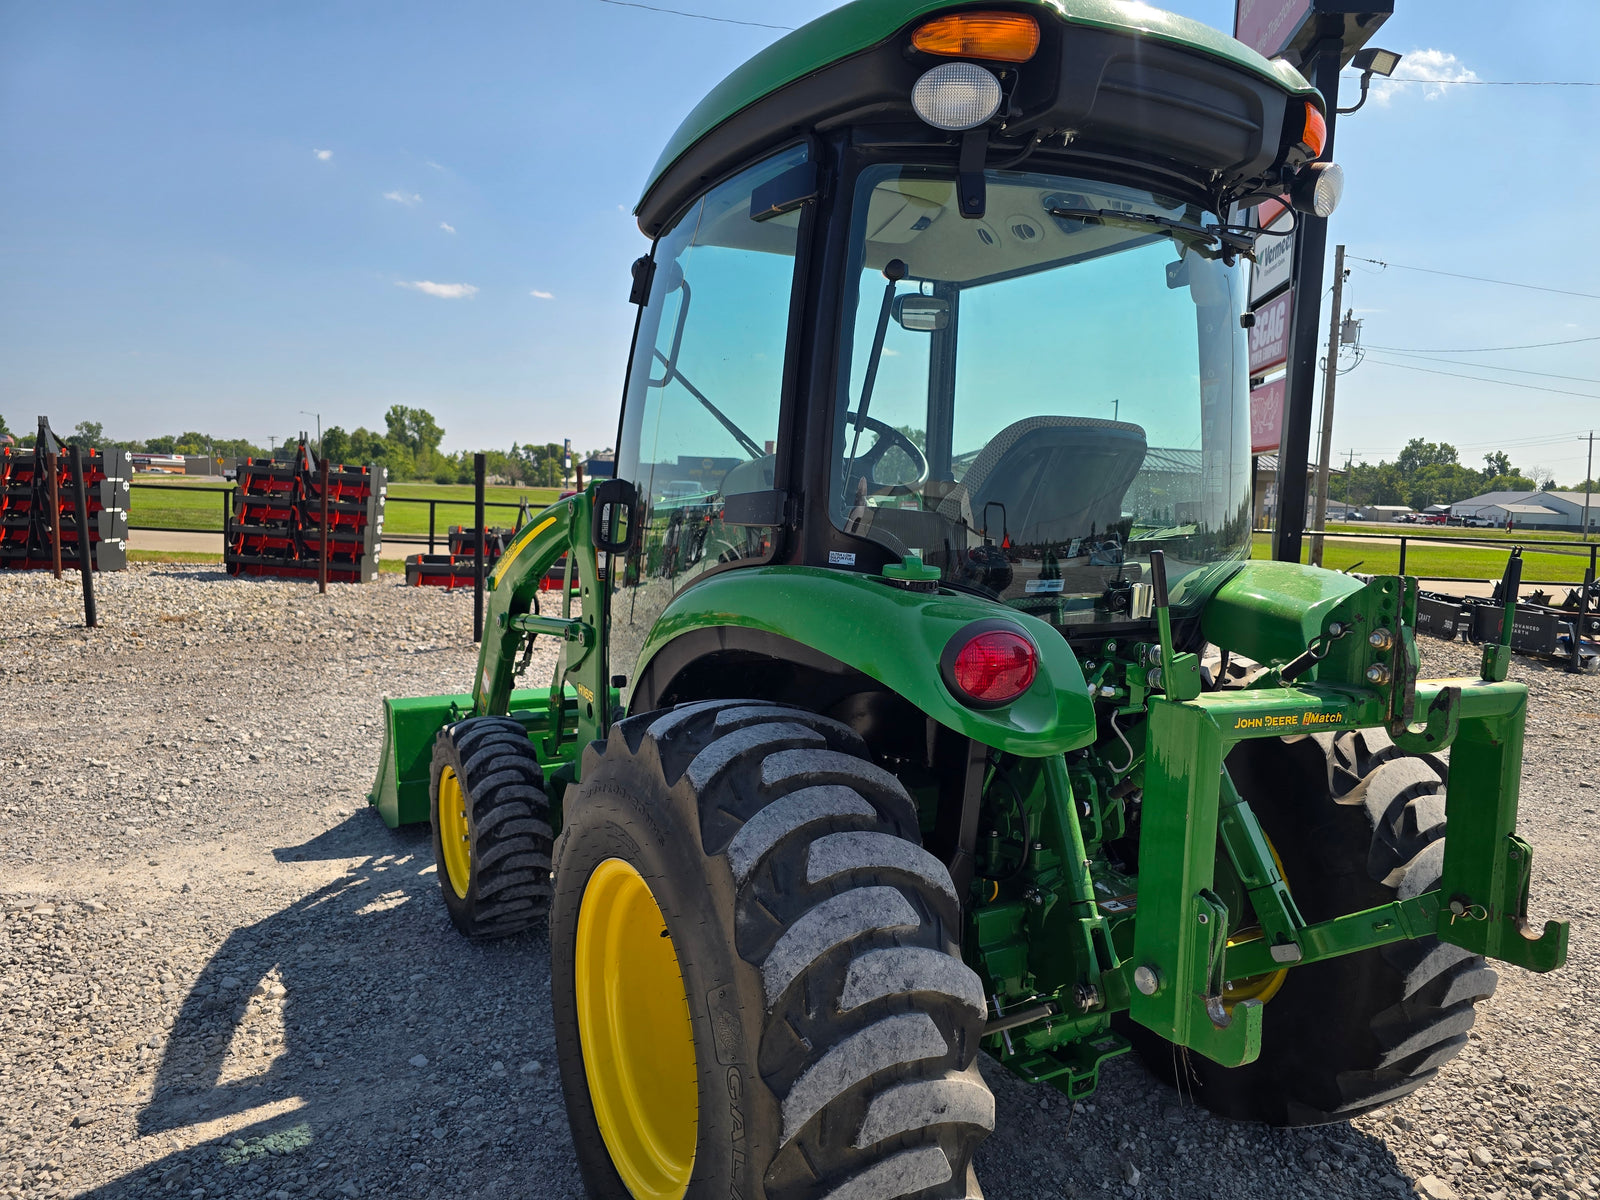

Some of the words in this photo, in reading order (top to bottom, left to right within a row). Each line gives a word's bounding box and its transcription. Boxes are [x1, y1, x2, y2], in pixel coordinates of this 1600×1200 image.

[1252, 301, 1285, 351] SCAG
[1234, 717, 1263, 729] JOHN
[1264, 715, 1299, 727] DEERE
